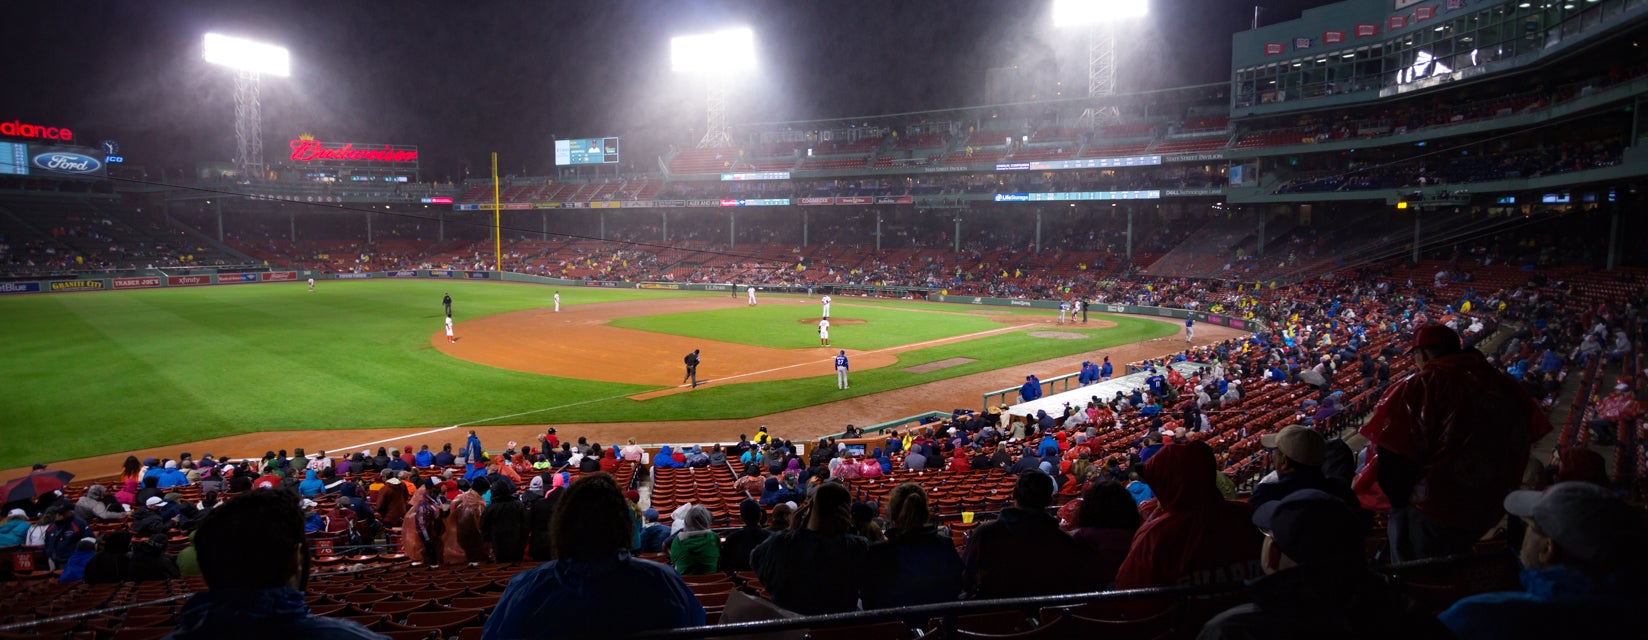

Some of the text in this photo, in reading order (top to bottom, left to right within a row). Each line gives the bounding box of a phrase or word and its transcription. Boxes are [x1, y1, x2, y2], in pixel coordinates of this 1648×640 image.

[289, 139, 418, 162] Budweiser
[47, 154, 89, 171] Ford
[51, 279, 102, 290] GRANITE CITY
[114, 278, 159, 287] TRADER JOE'S
[178, 276, 200, 285] xfinity
